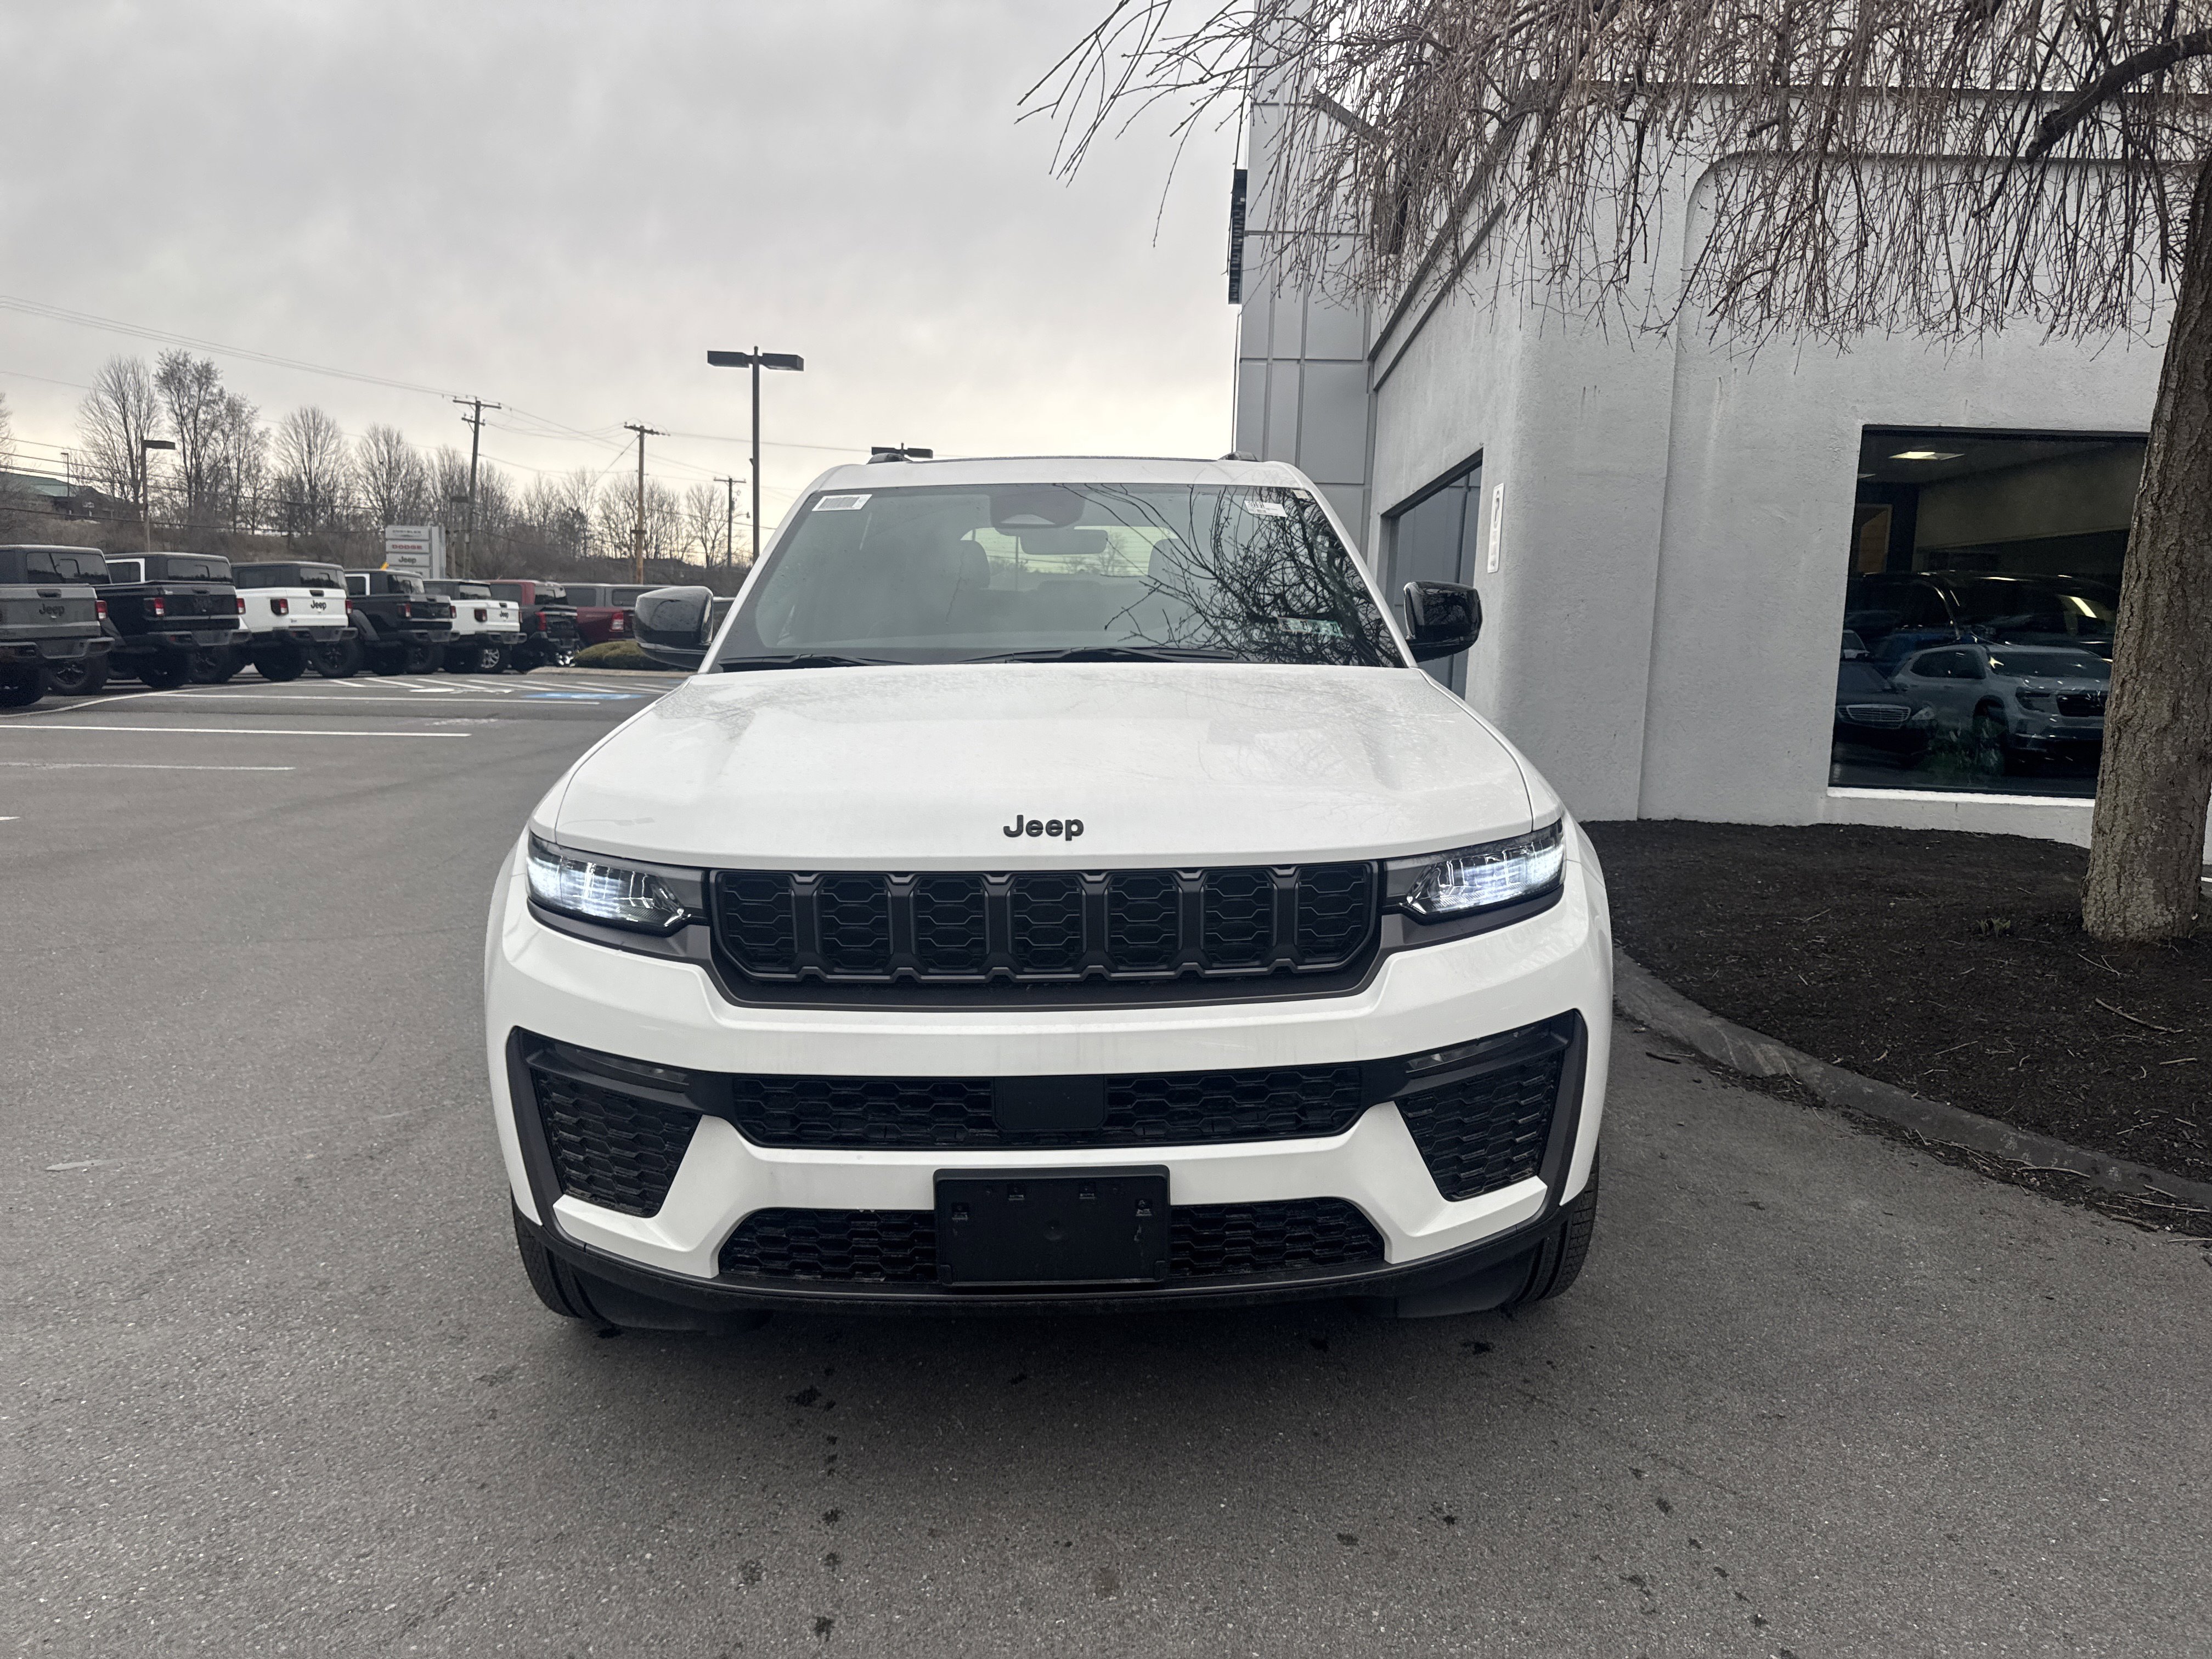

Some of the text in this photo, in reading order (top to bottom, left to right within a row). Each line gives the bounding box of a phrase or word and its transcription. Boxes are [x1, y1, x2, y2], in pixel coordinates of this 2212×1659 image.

[38, 603, 65, 616] Jeep
[311, 600, 326, 610] Jeep
[1003, 815, 1084, 841] Jeep
